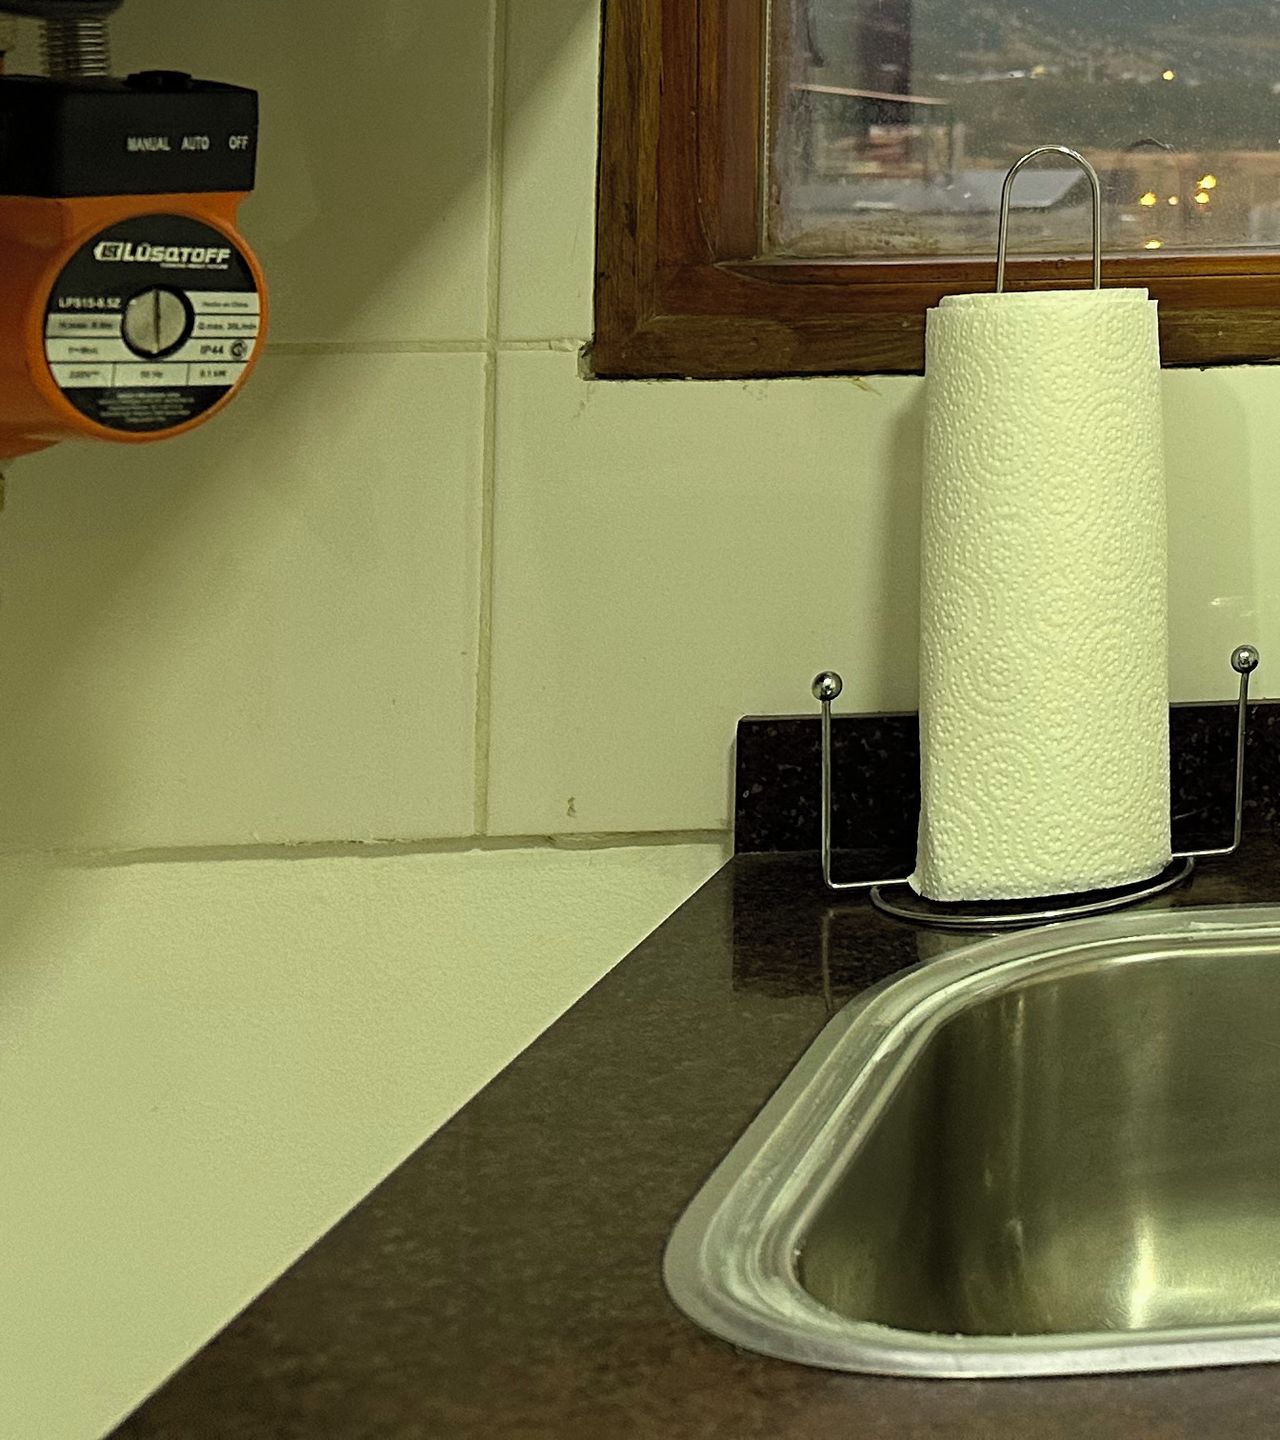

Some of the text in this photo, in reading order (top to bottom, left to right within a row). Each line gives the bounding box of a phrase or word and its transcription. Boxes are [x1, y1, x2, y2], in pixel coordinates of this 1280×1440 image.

[127, 135, 249, 151] MANUAL AUTO OFF
[200, 345, 225, 355] IP44
